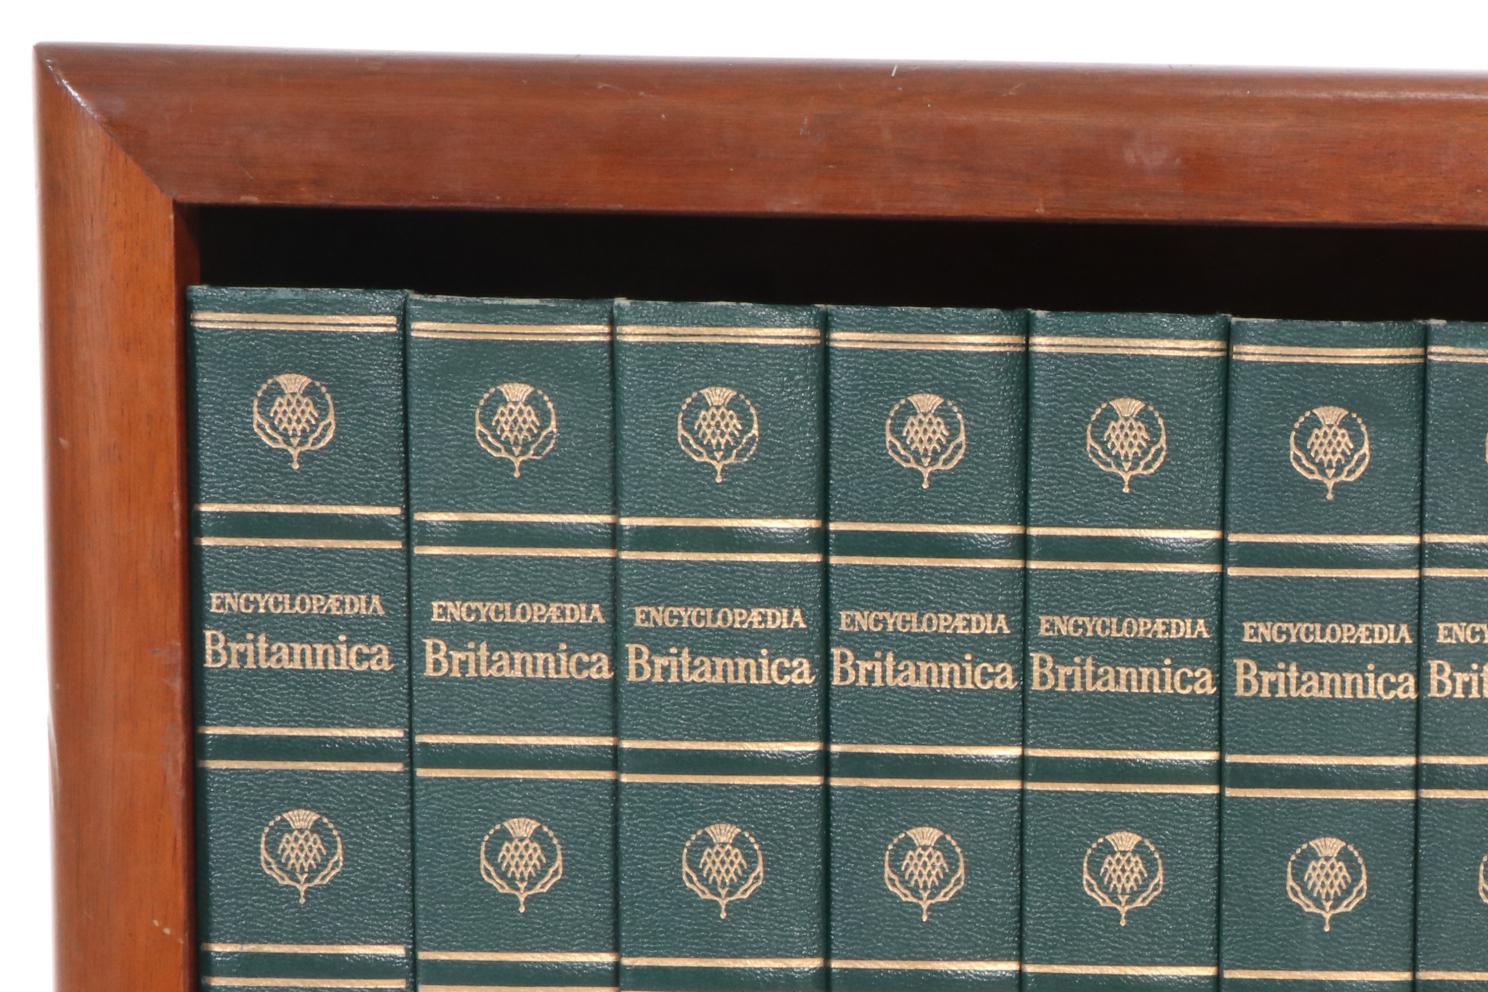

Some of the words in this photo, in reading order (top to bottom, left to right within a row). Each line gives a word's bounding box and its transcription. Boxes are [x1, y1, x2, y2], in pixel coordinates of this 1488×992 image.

[204, 629, 395, 672] Britannica
[423, 636, 615, 681] Britannica
[625, 642, 816, 686] Britannica
[831, 646, 1018, 690] Britannica
[1030, 651, 1217, 695] Britannica
[1234, 657, 1418, 701] Britannica
